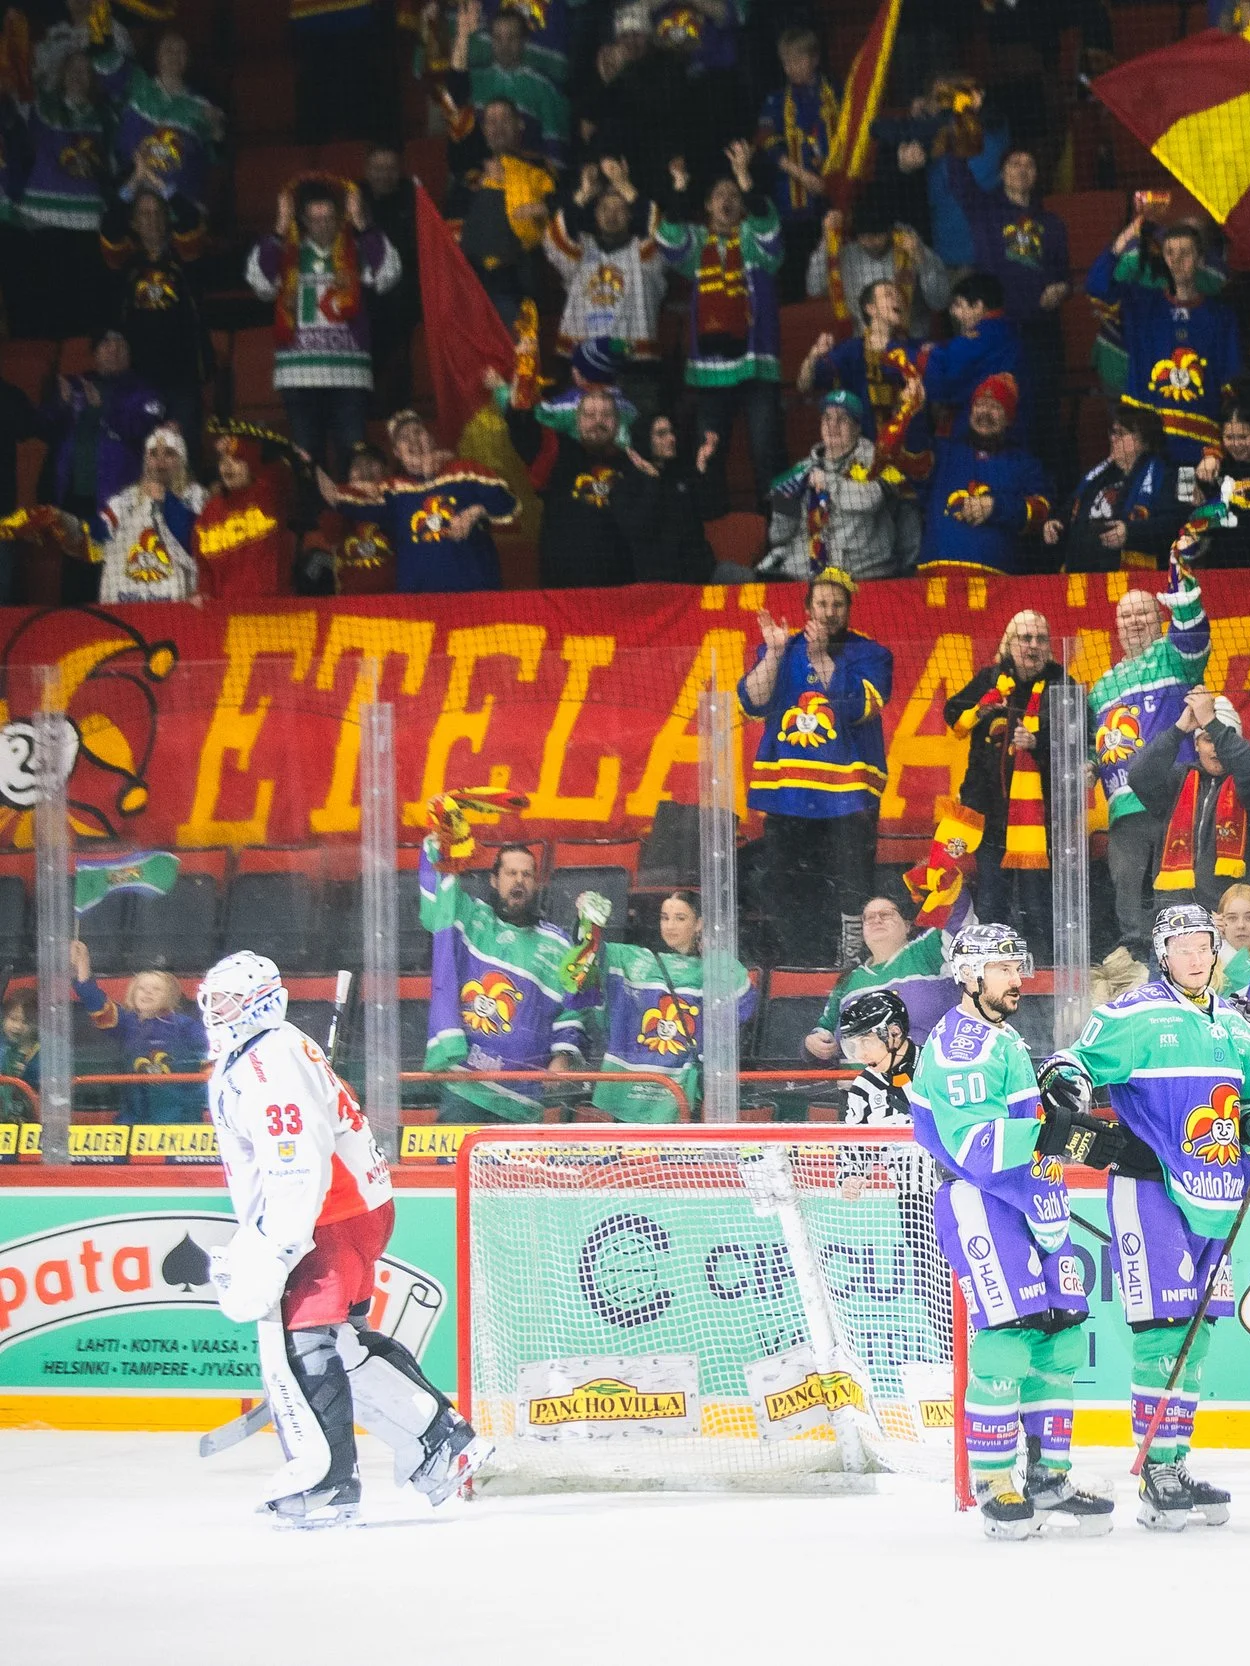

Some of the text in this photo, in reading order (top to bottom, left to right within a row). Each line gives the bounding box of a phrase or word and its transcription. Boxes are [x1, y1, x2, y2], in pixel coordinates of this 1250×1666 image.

[1160, 1033, 1179, 1044] RTK
[946, 1072, 987, 1106] 50
[267, 1103, 303, 1137] 33
[1183, 1171, 1222, 1199] Saldo
[0, 1238, 152, 1331] pata
[978, 1262, 1004, 1309] HALTI
[1019, 1281, 1046, 1301] INFU
[1126, 1260, 1143, 1306] HALTI
[76, 1337, 240, 1354] LAHTI KOTKA VAASA
[43, 1358, 262, 1377] HELSINKI TAMPERE JYVÄSKY
[535, 1396, 682, 1419] PANCHO VILLA
[773, 1380, 839, 1414] PANCO
[925, 1402, 954, 1421] PAN
